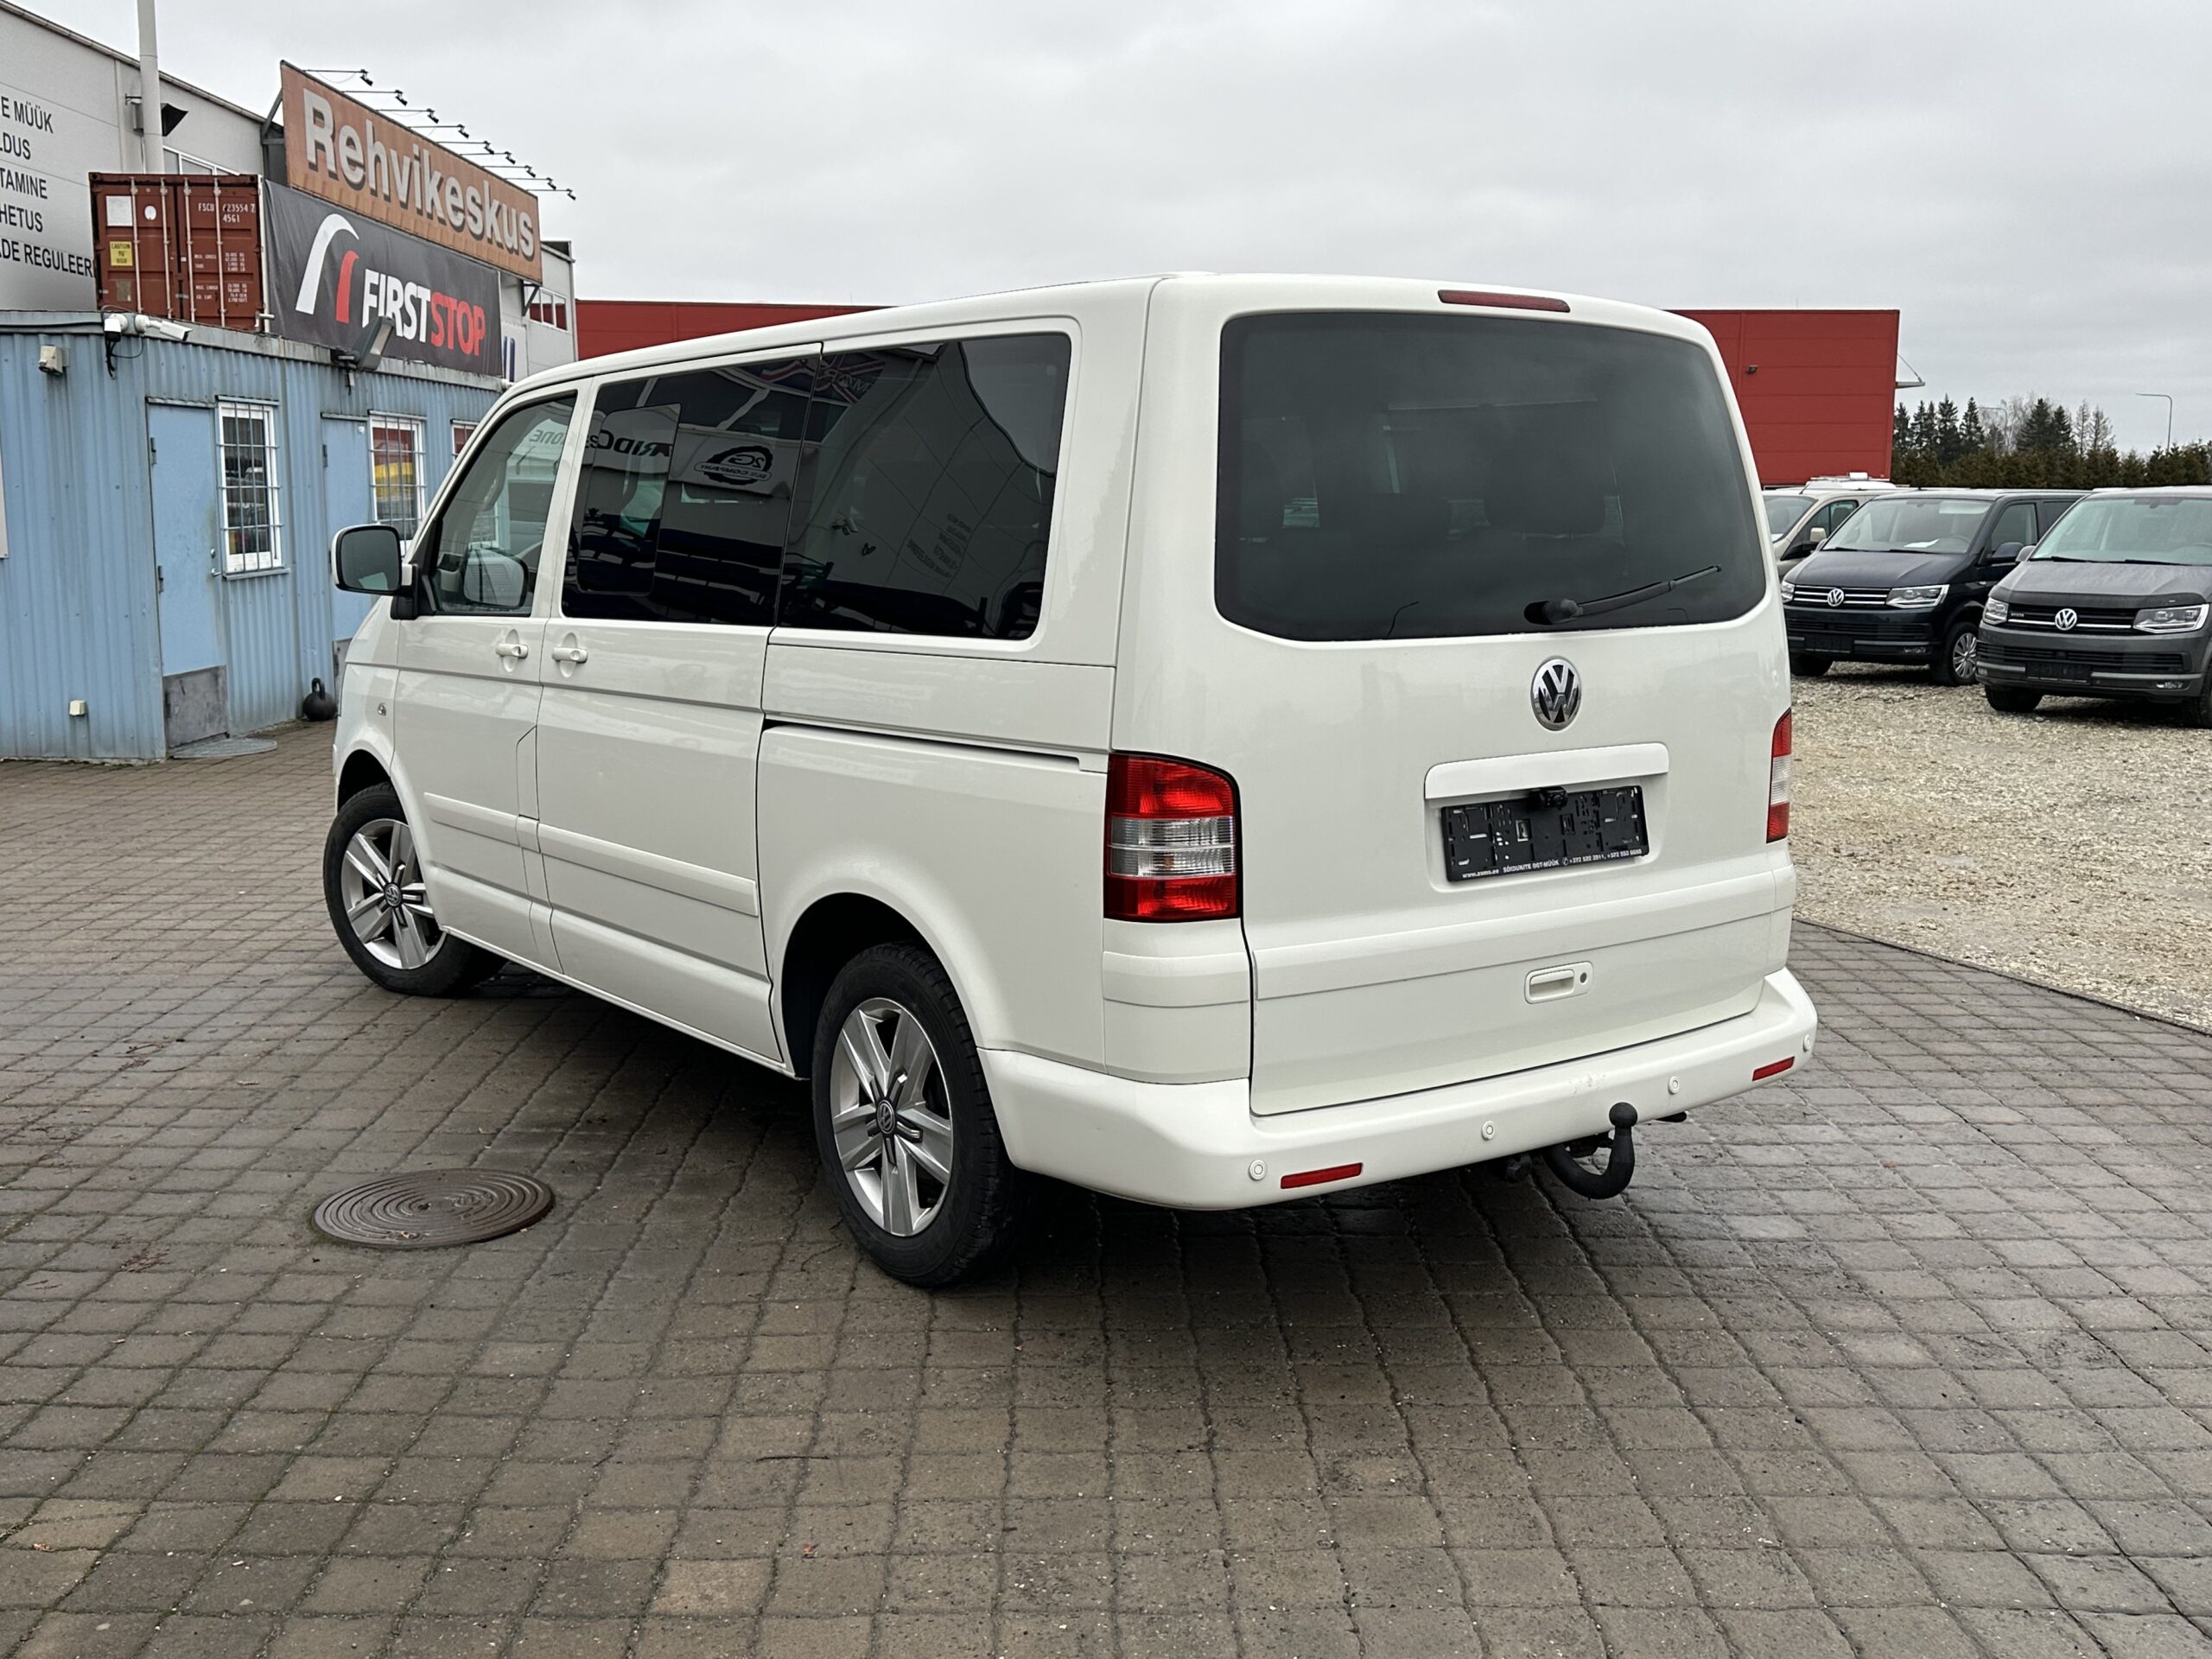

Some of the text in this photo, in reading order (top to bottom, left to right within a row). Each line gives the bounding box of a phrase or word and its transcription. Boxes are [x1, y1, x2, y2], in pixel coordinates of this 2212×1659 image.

[14, 100, 54, 133] MÜÜK
[0, 132, 31, 160] DUS
[0, 168, 48, 200] TAMINE
[303, 87, 535, 261] Rehvikeskus
[0, 238, 93, 277] DE REGULEER
